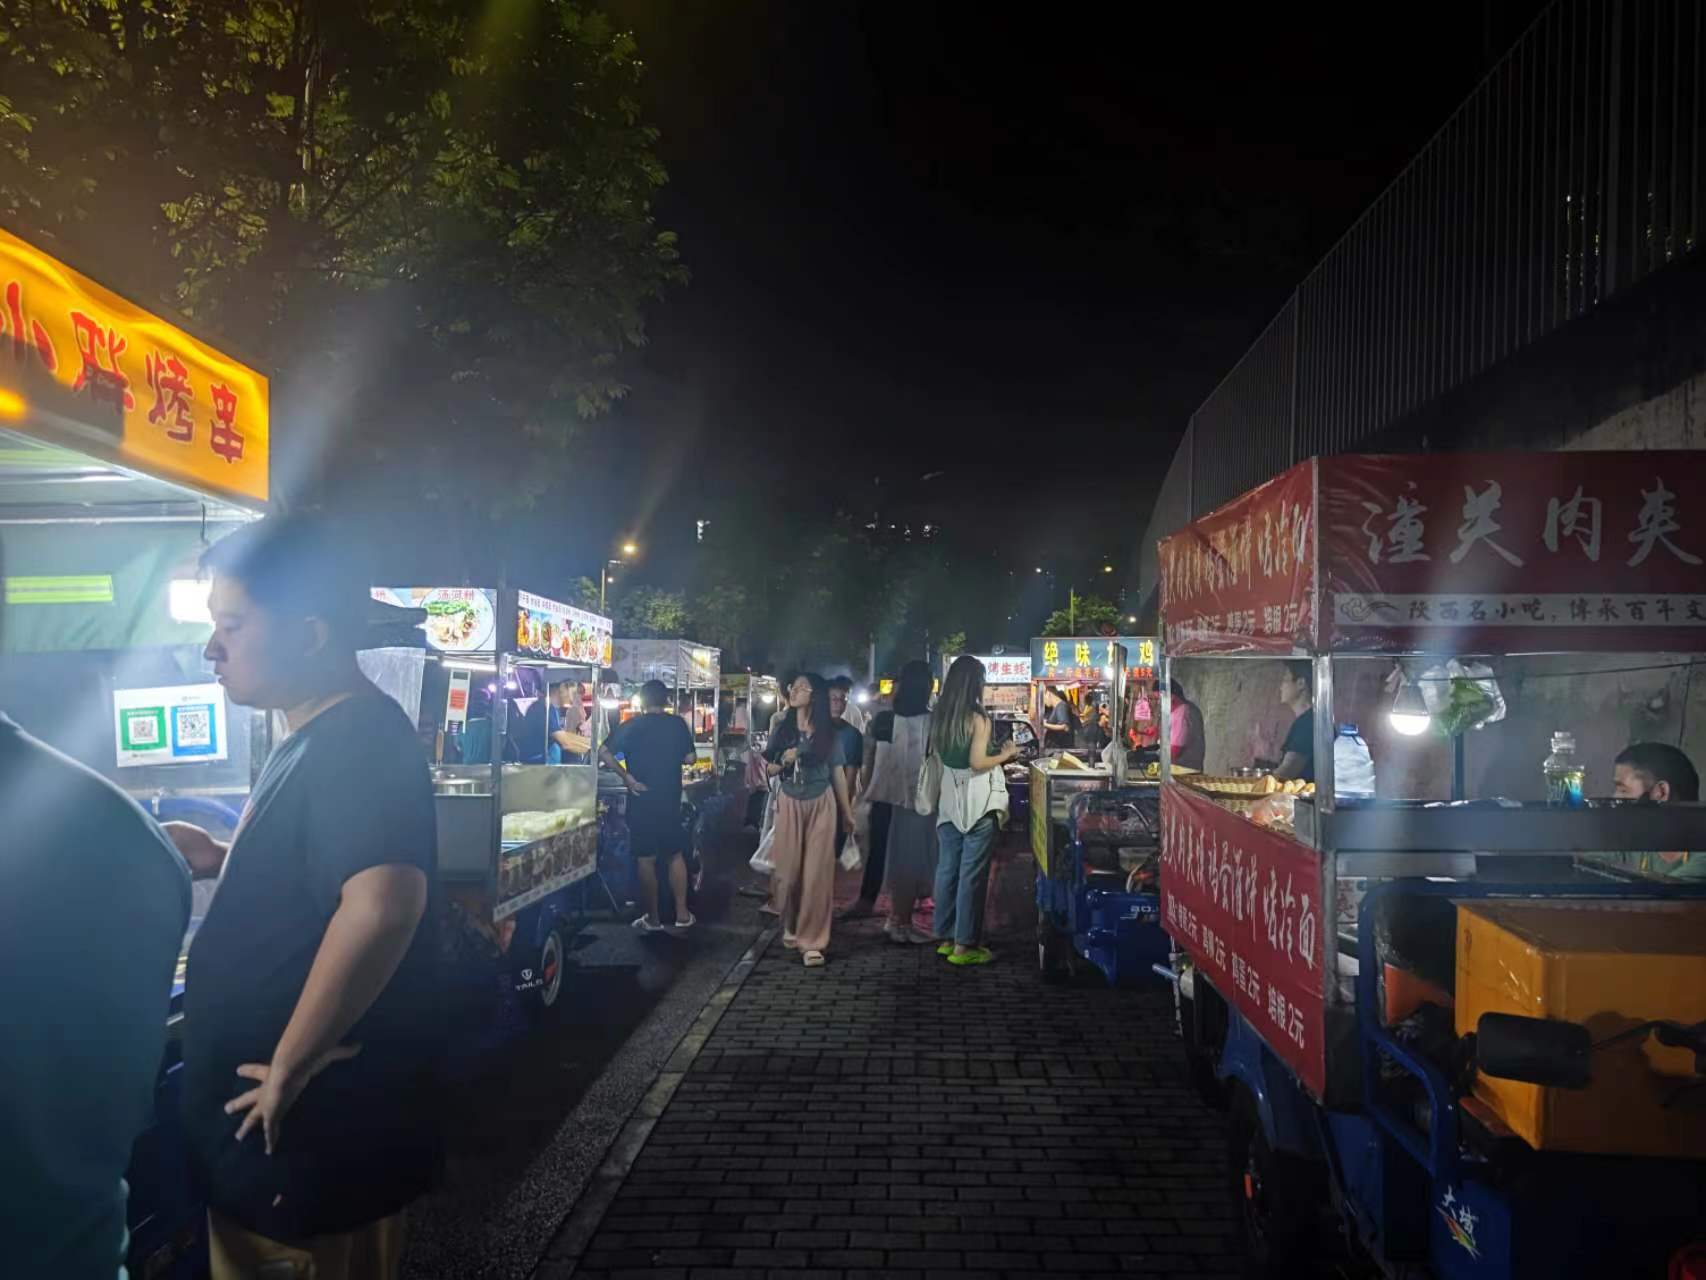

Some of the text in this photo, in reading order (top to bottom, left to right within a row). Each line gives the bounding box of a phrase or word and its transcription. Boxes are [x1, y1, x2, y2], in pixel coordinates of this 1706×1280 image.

[1361, 476, 1704, 567] 潼关肉夹
[1044, 640, 1154, 667] 绝味鸡
[1263, 865, 1317, 970] 烤冷面
